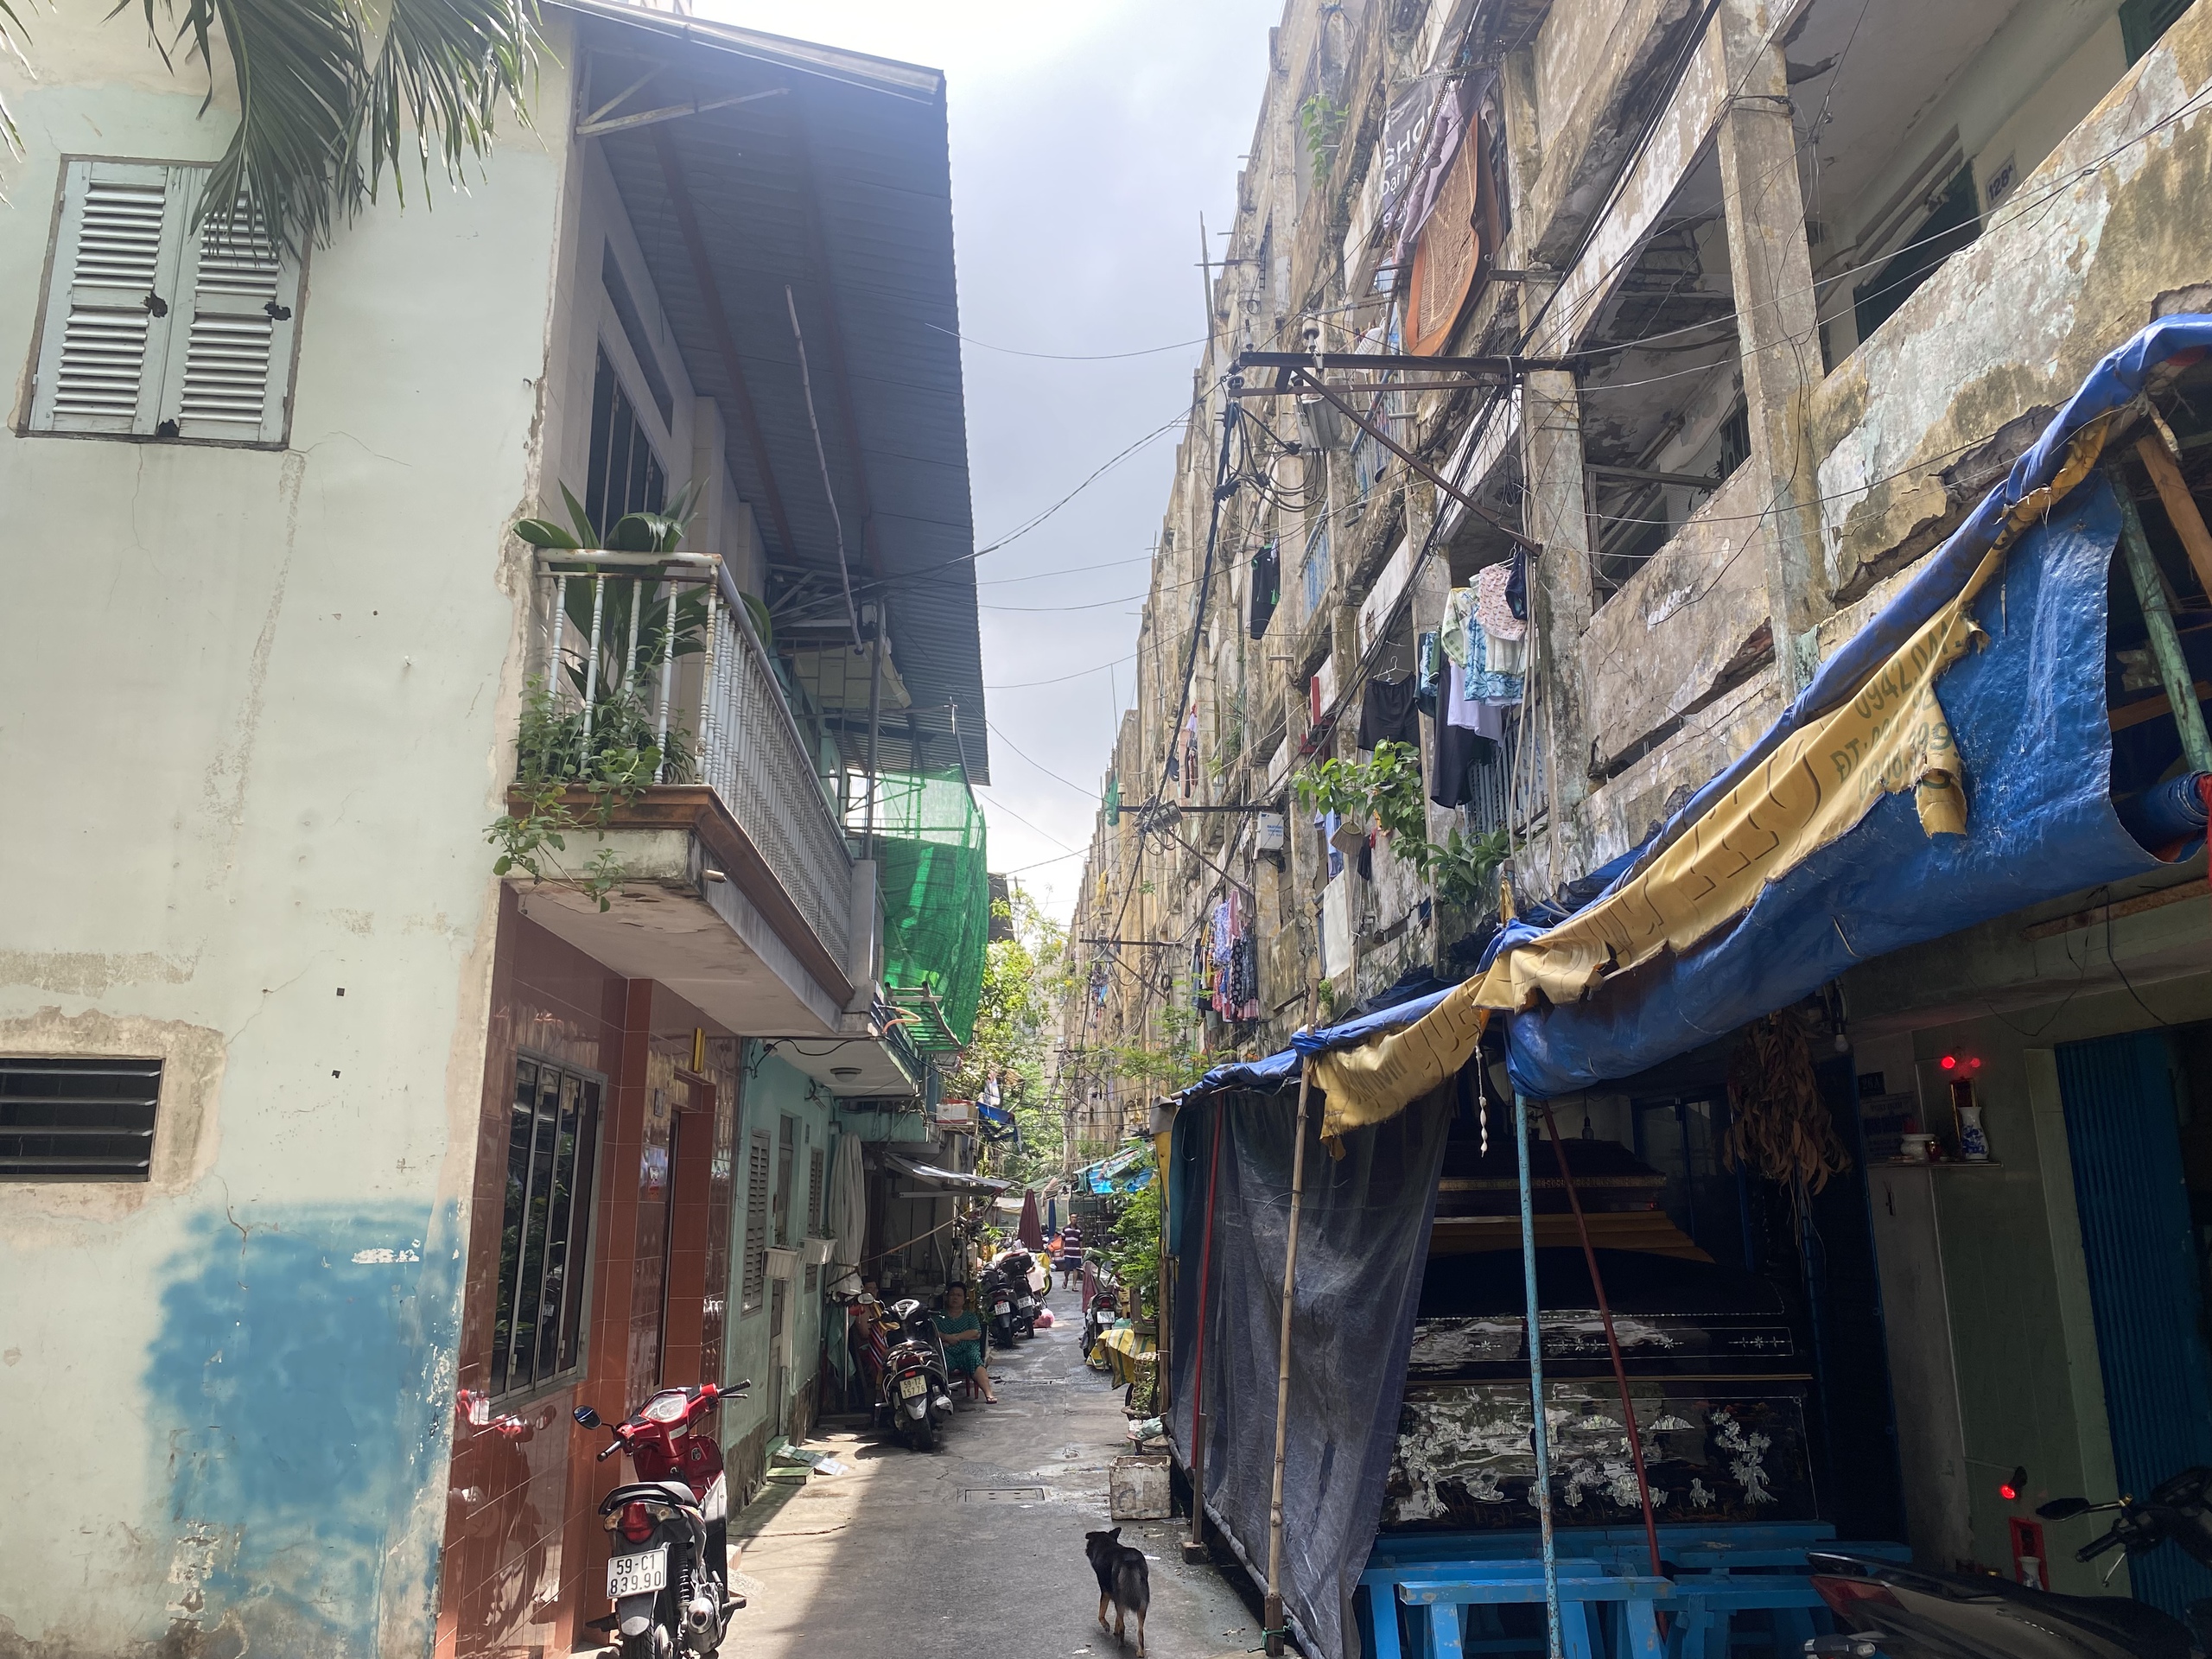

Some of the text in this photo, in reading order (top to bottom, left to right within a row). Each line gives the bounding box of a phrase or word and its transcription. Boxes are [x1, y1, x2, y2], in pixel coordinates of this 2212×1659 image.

[1384, 100, 1435, 170] SHO
[616, 1554, 655, 1575] 59-C1
[610, 1571, 662, 1594] 839.90
